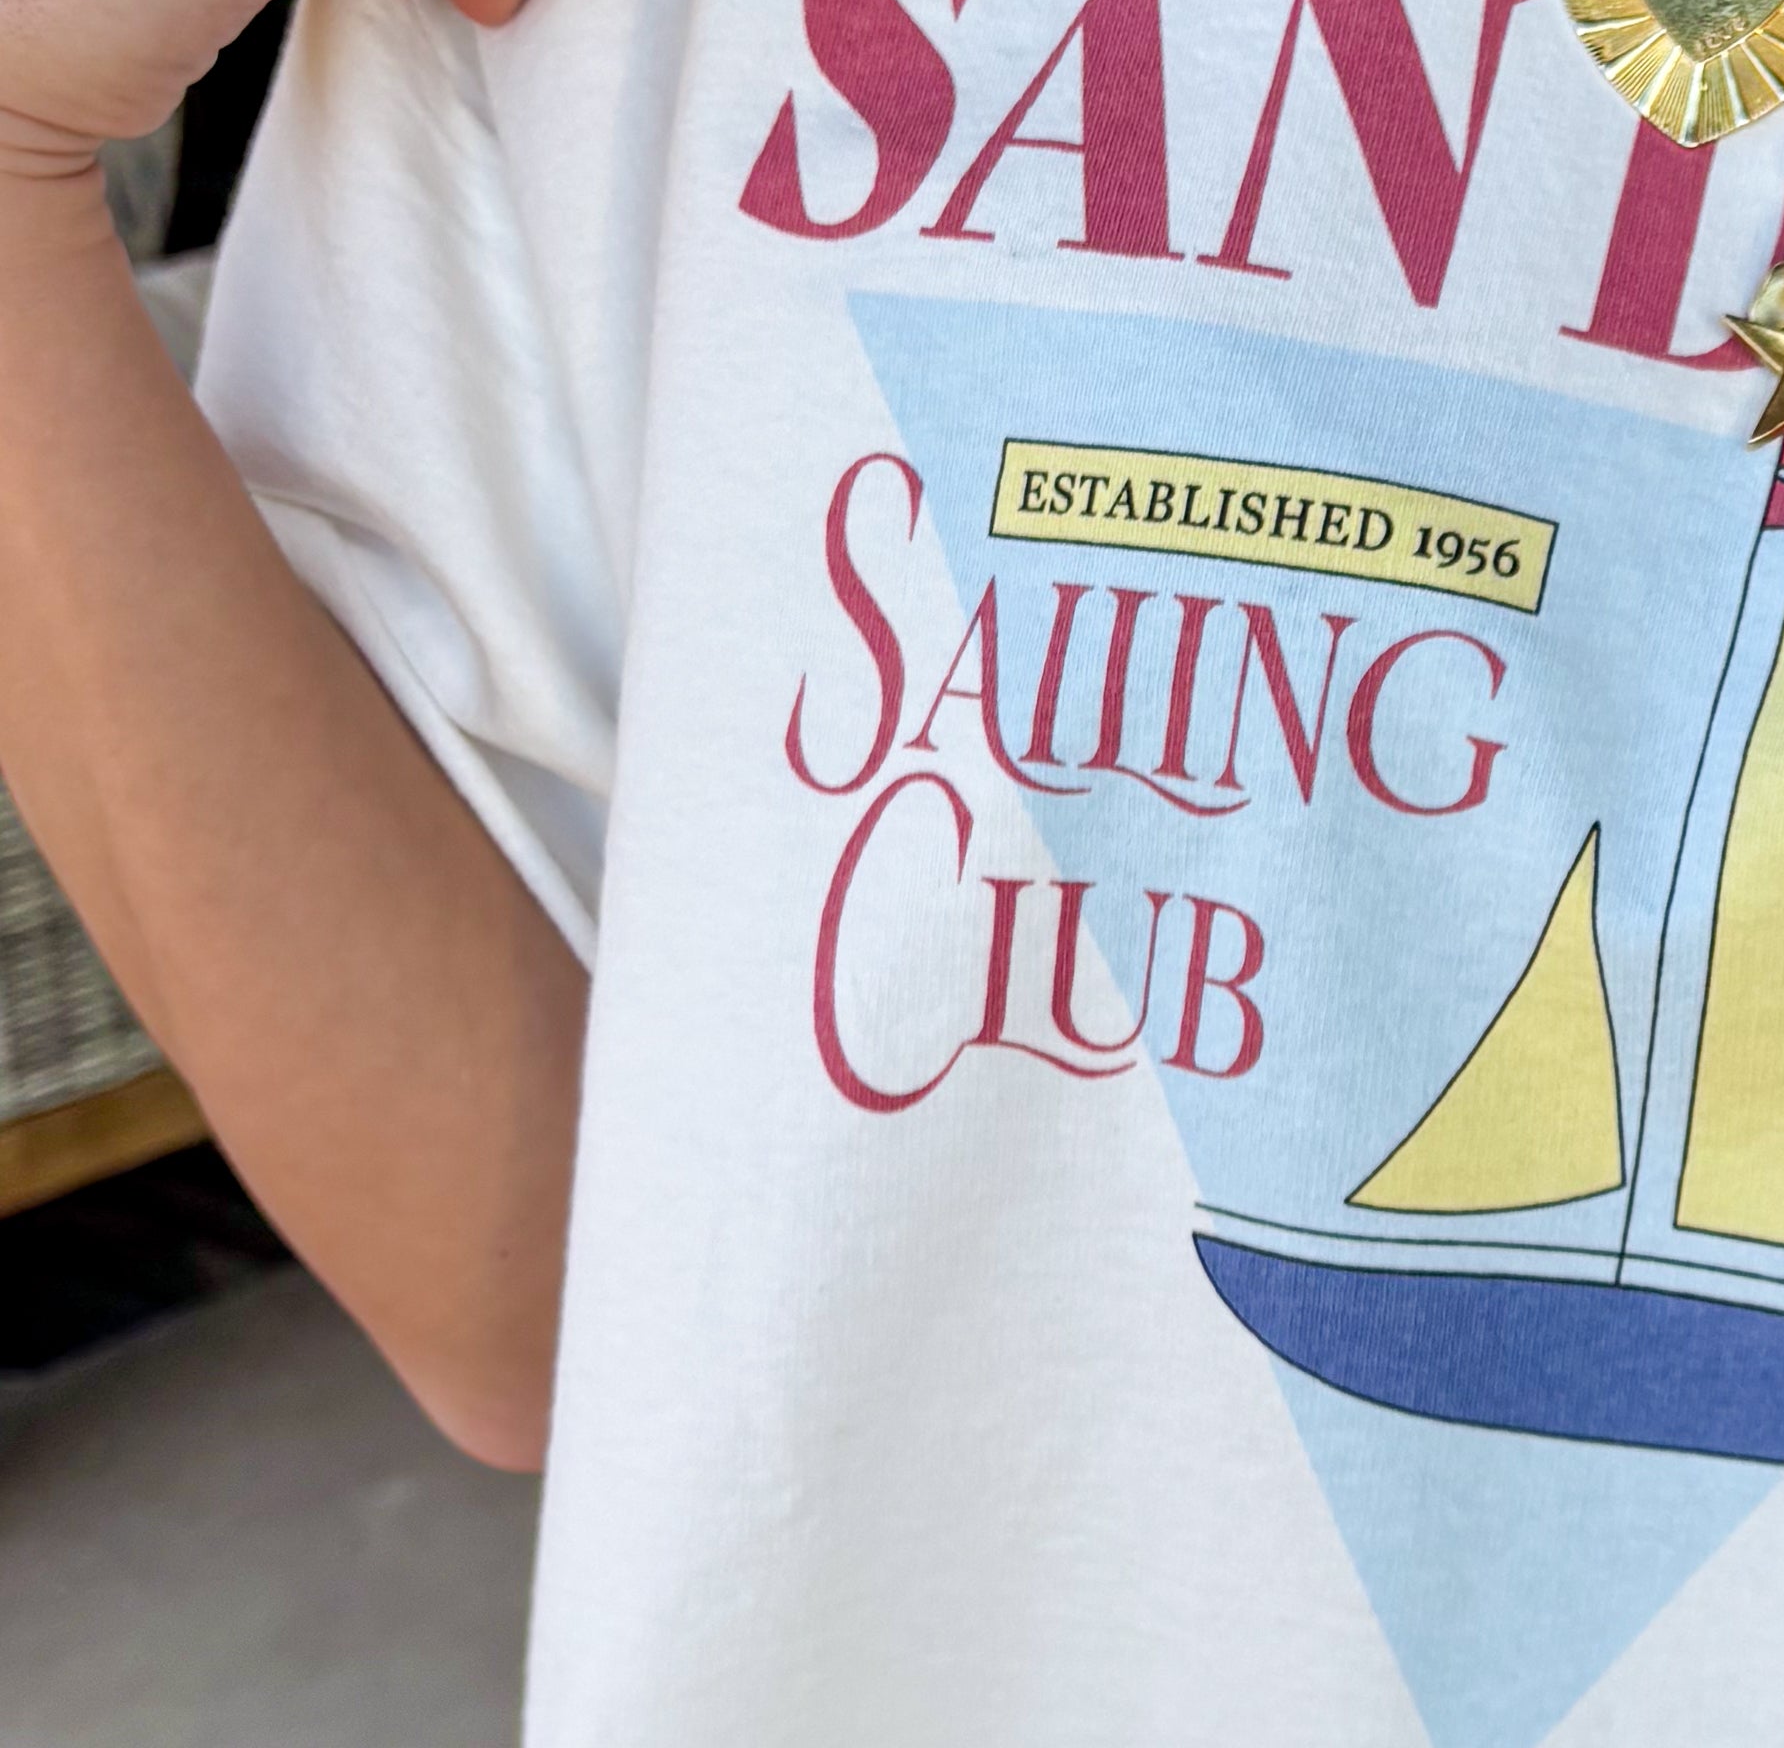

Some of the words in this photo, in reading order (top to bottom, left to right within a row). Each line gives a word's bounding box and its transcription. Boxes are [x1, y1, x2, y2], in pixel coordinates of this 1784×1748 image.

[784, 453, 1507, 816] SAILING
[1017, 470, 1394, 551] ESTABLISHED
[1413, 522, 1522, 579] 1956
[813, 772, 1266, 1113] CLUB
